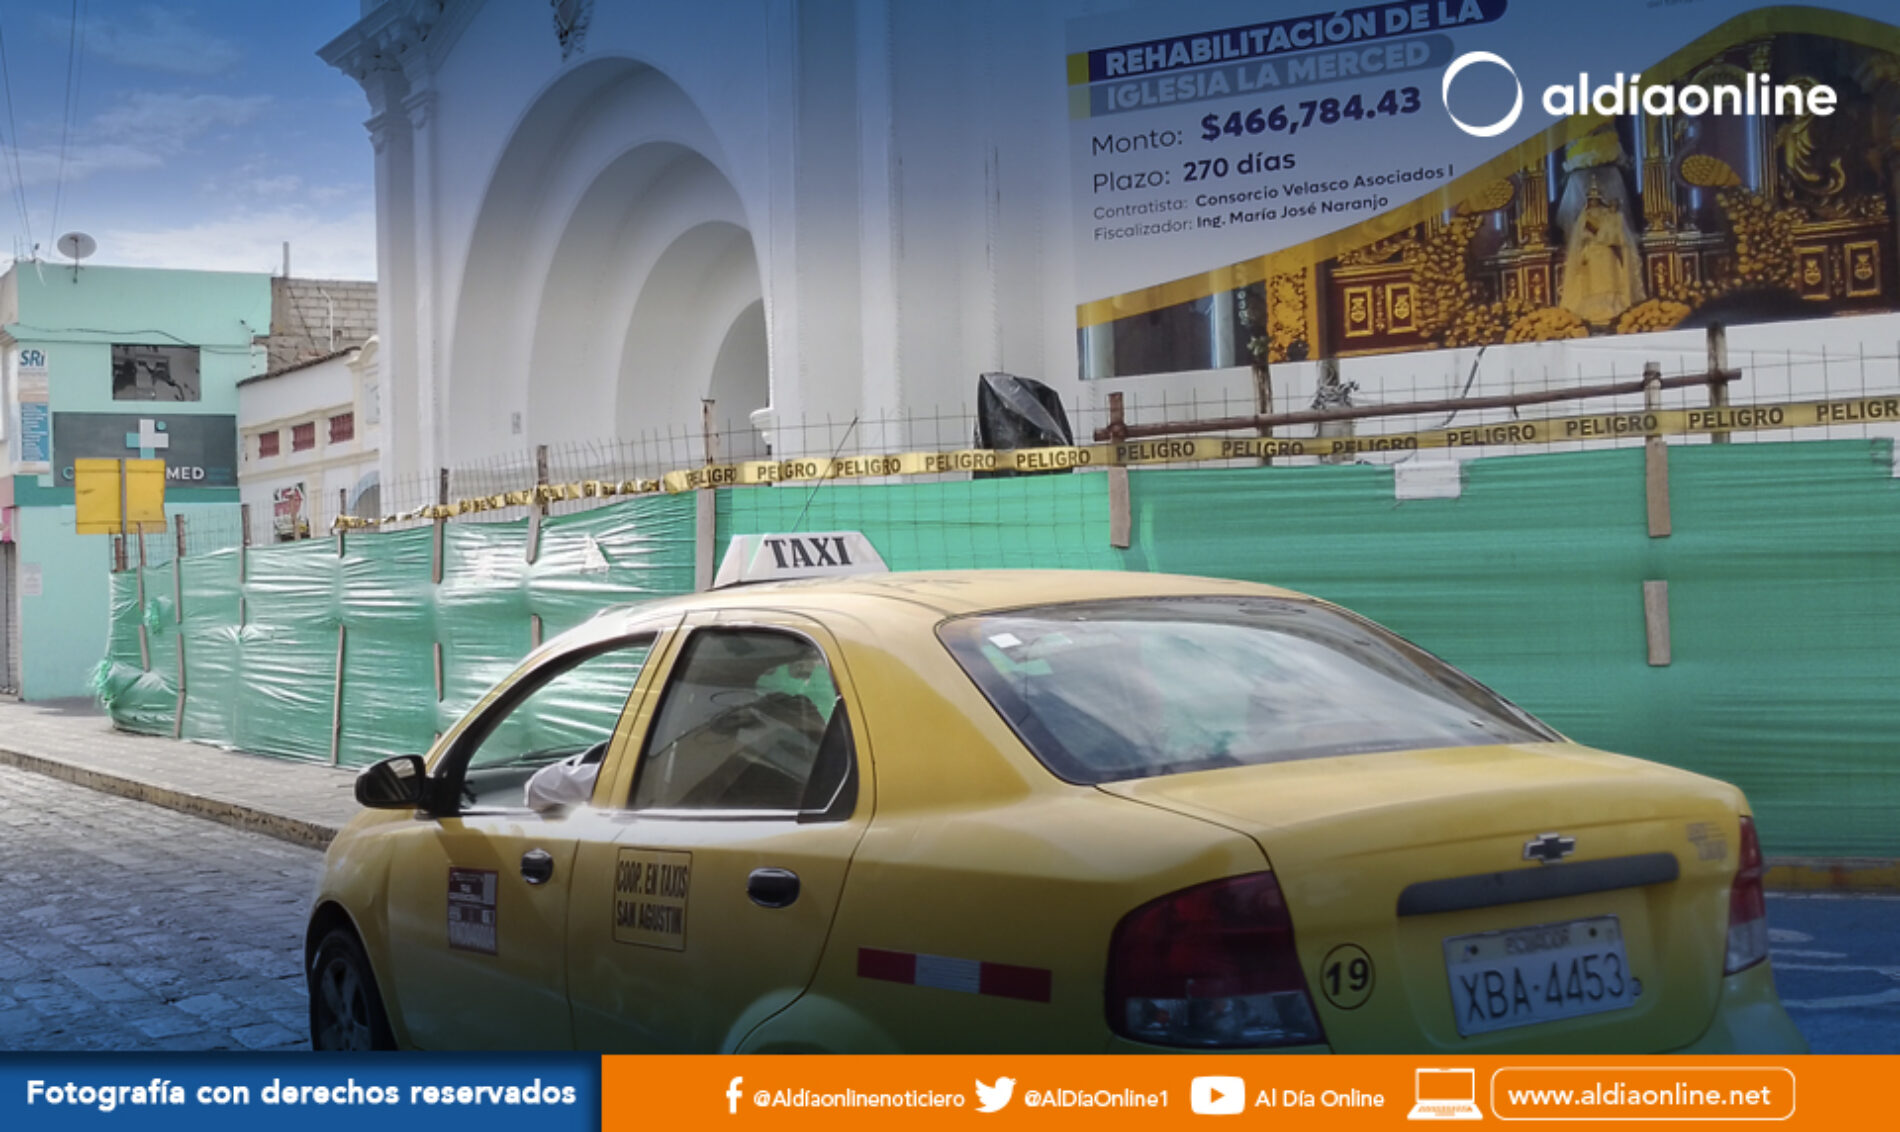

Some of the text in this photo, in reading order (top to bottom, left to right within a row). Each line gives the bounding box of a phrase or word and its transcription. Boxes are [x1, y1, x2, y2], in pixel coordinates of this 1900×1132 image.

[1106, 0, 1483, 76] REHABILITACIÓN DE LA
[1107, 41, 1430, 110] IGLESIA LA MERCED
[1092, 86, 1421, 156] Monto: $466,784.43
[1093, 151, 1296, 194] Plazo: 270 días
[1093, 199, 1189, 220] Contratista:
[1195, 185, 1279, 207] Consorcio
[1282, 177, 1349, 198] Velasco
[1353, 166, 1444, 189] Asociados
[1094, 194, 1389, 241] Fiscalizador: Ing. María José Naranjo
[836, 458, 901, 477] PELIGRO
[925, 453, 997, 471] PELIGRO
[1016, 449, 1091, 469] PELIGRO
[1116, 440, 1196, 462] PELIGRO
[1221, 440, 1304, 459] PELIGRO
[1332, 436, 1418, 454] PELIGRO
[1446, 424, 1536, 448] PELIGRO
[1566, 414, 1658, 437] PELIGRO
[1688, 406, 1785, 430] PELIGRO
[1815, 399, 1900, 423] PELIGR
[687, 467, 736, 490] PELIGR
[763, 536, 853, 569] TAXI
[660, 864, 688, 898] TAXIS
[1326, 957, 1370, 996] 19
